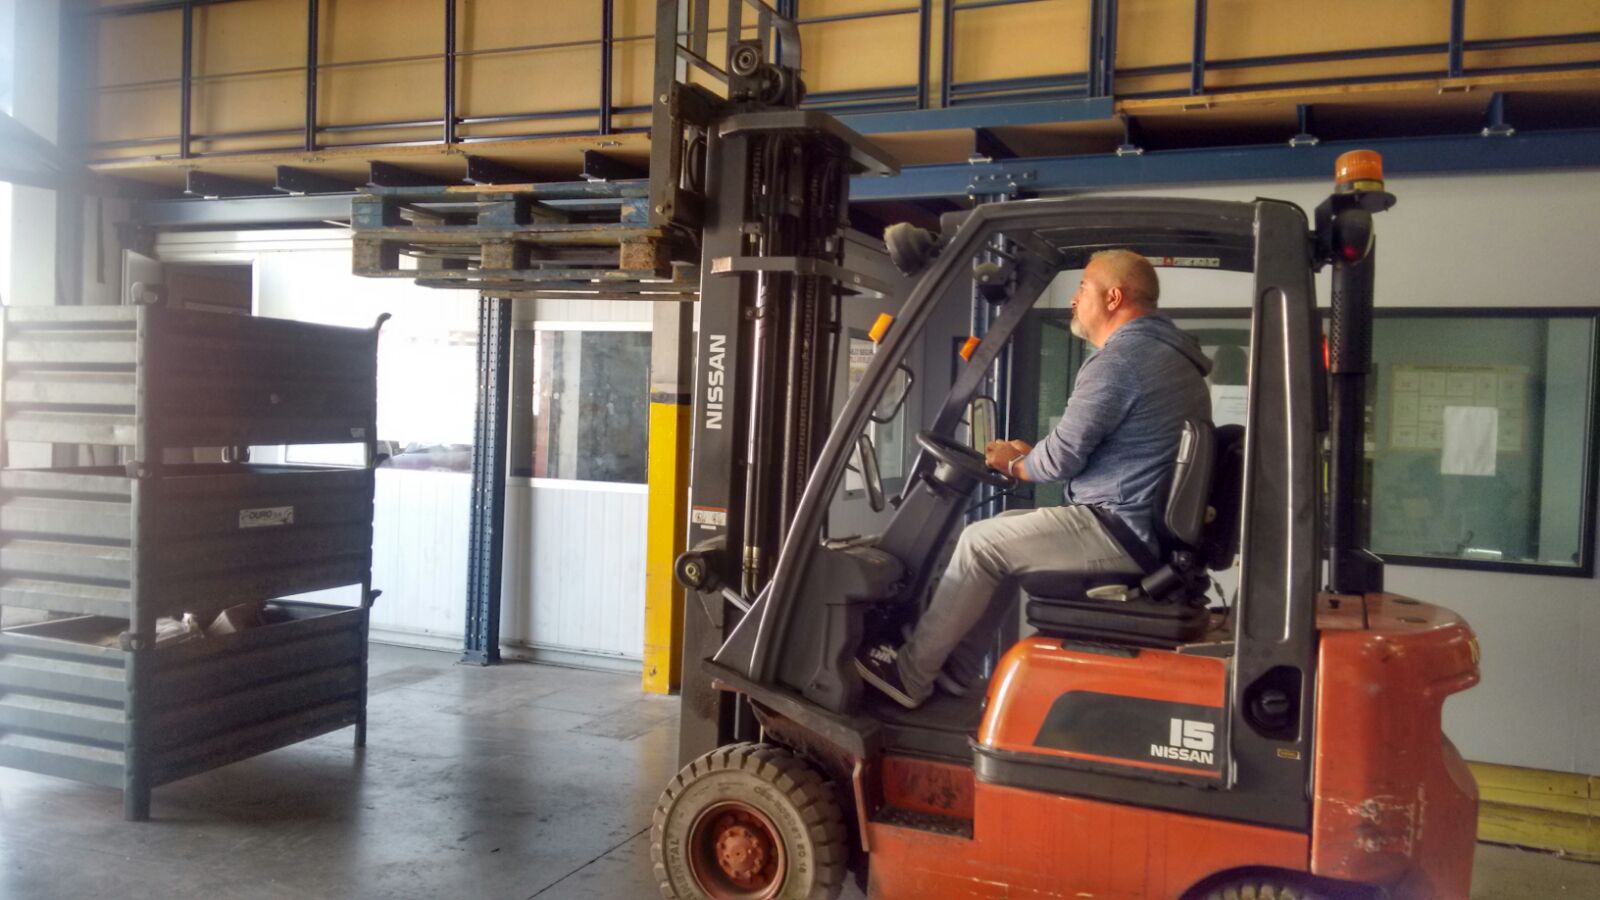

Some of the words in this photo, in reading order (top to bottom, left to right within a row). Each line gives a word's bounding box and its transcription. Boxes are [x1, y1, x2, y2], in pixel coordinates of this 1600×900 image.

[706, 334, 727, 429] NISSAN
[1169, 718, 1215, 751] 15
[1150, 744, 1214, 765] NISSAN
